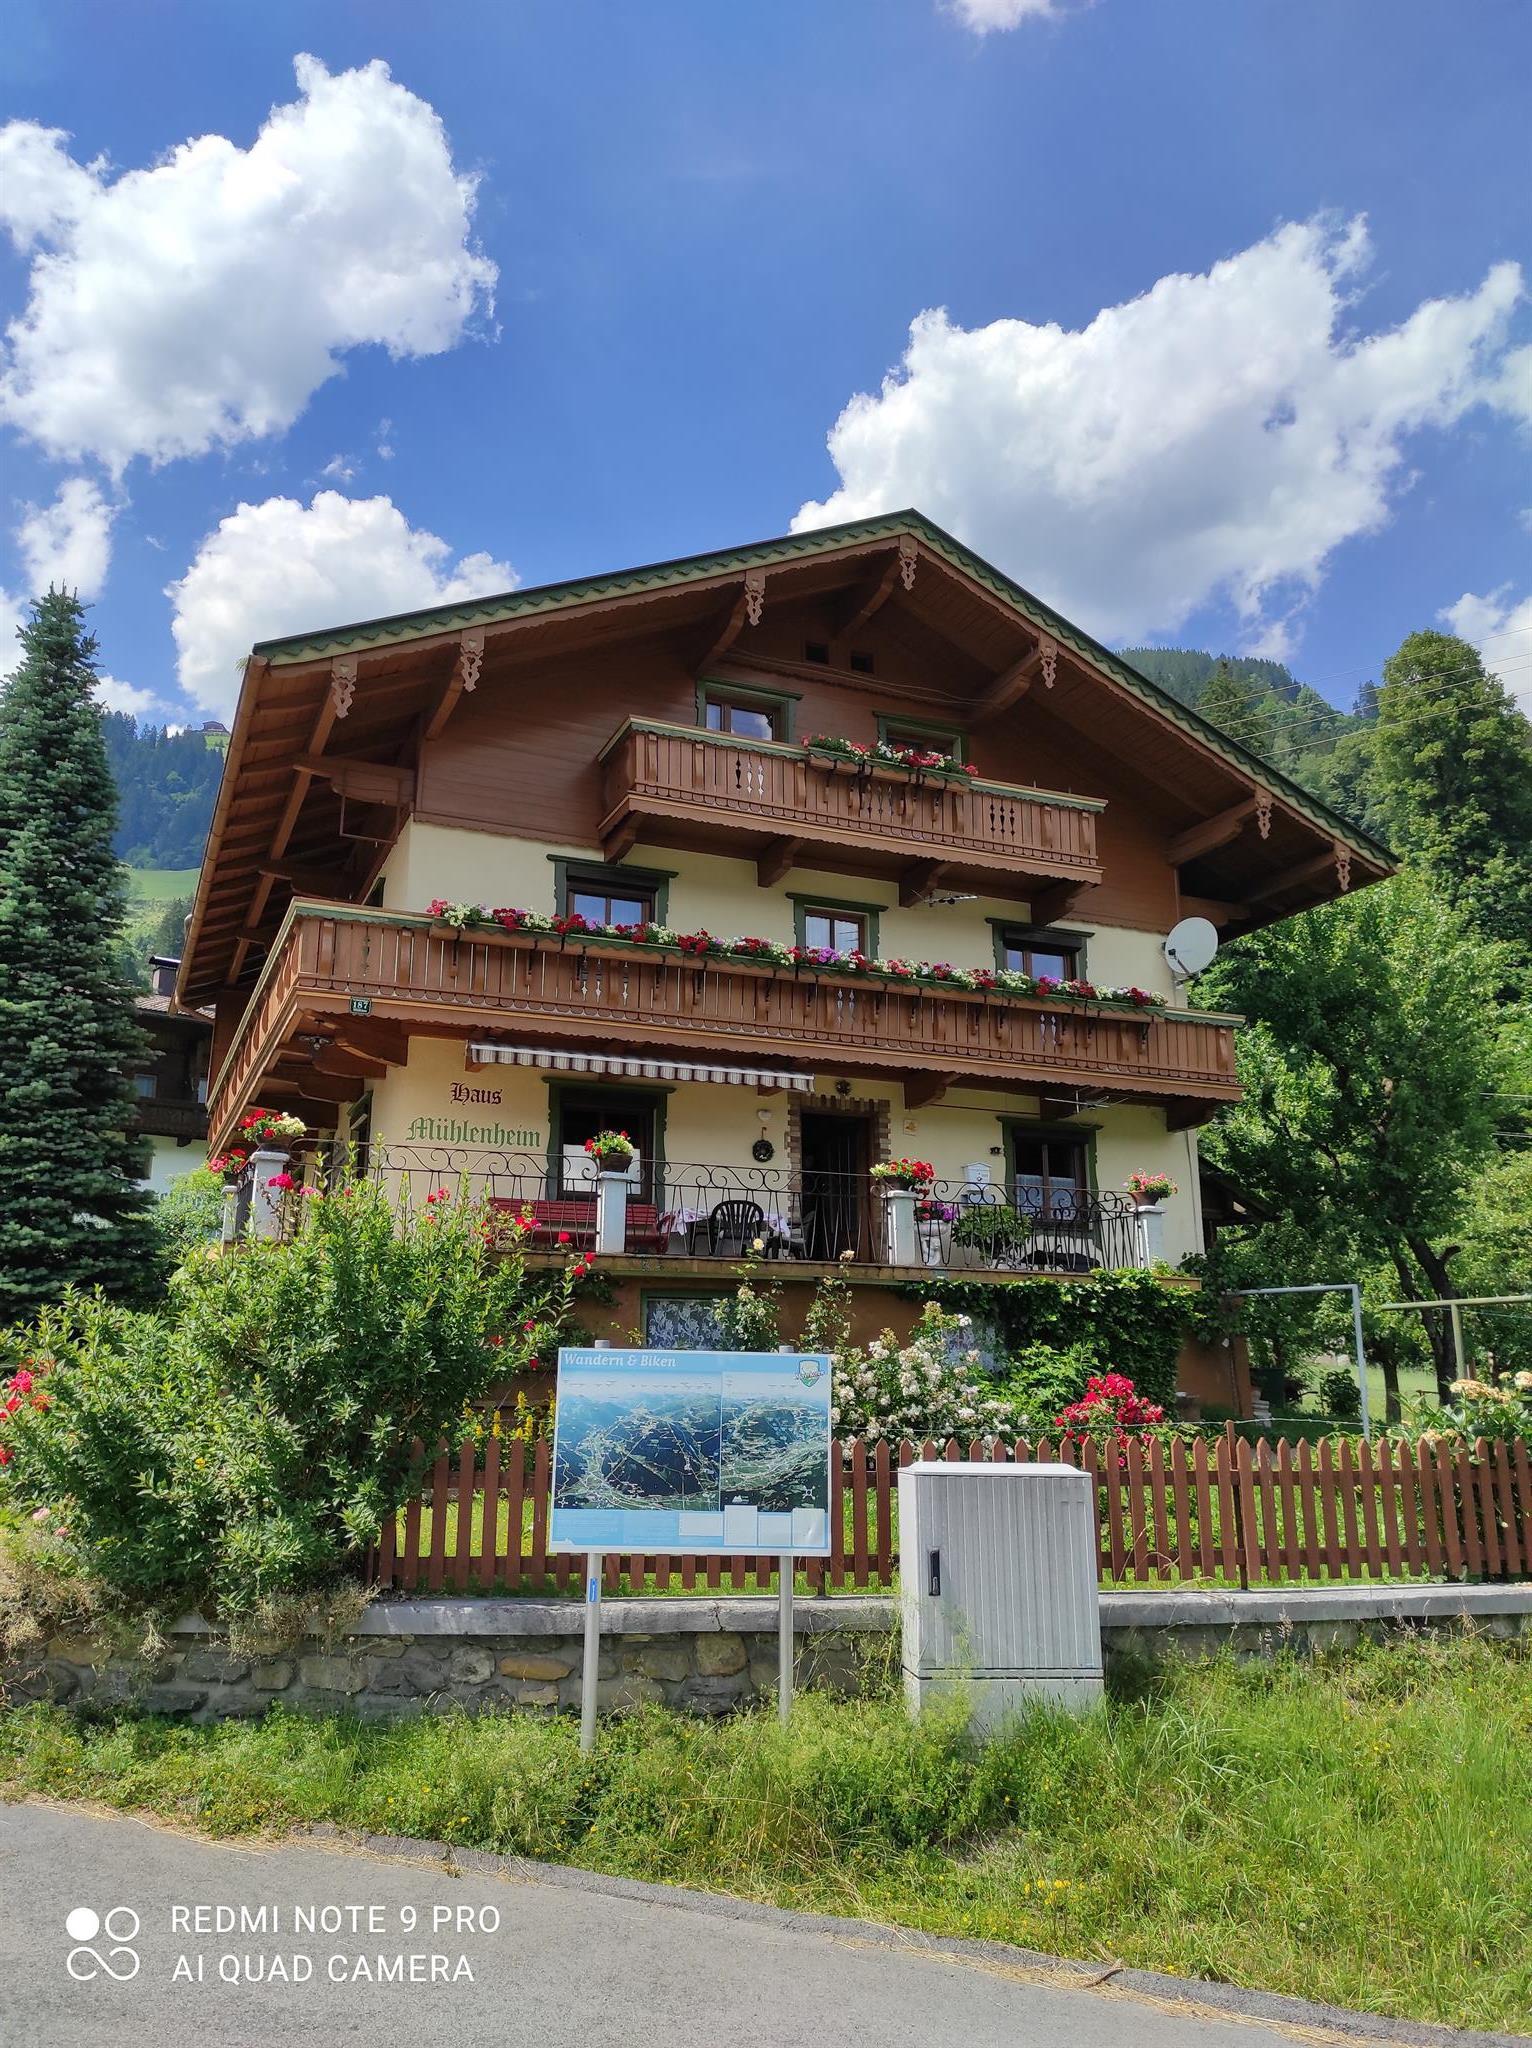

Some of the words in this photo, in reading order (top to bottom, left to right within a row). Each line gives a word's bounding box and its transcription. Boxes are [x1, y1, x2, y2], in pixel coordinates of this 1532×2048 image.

[352, 1001, 369, 1010] 187
[450, 1082, 503, 1105] Haus
[406, 1117, 541, 1148] Mühlenheim
[564, 1353, 625, 1367] Wandern
[627, 1355, 638, 1367] &
[640, 1355, 677, 1368] Biken
